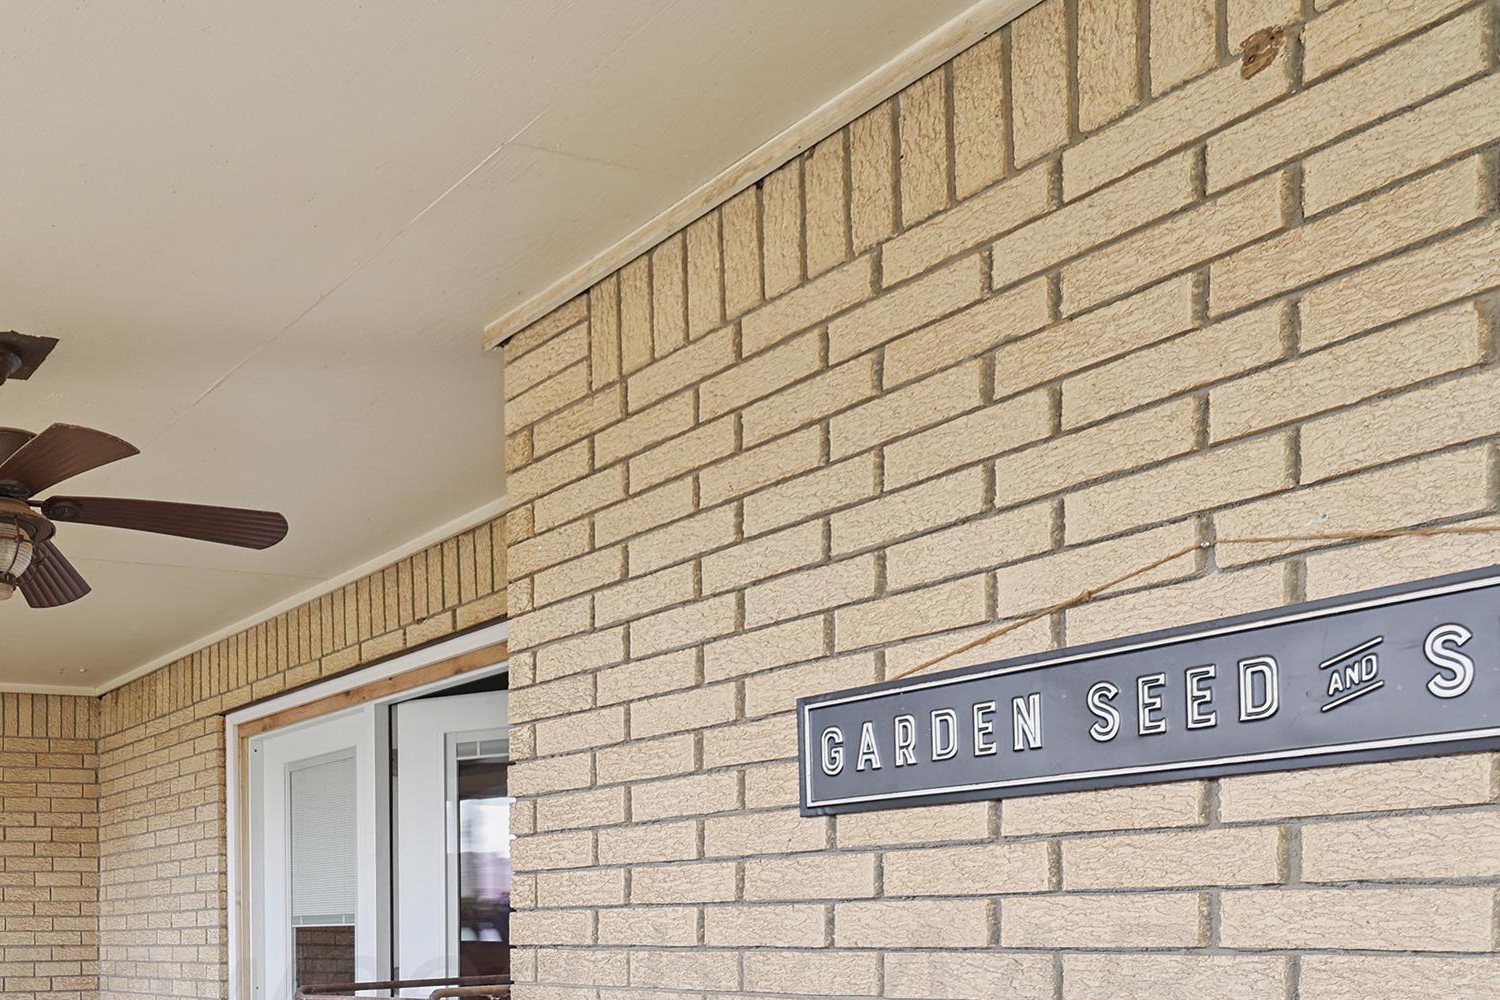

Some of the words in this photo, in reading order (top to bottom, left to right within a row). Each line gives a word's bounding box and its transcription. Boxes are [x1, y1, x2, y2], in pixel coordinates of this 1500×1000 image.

[821, 692, 1043, 776] GARDEN
[1086, 655, 1280, 743] SEED
[1328, 653, 1379, 696] AND
